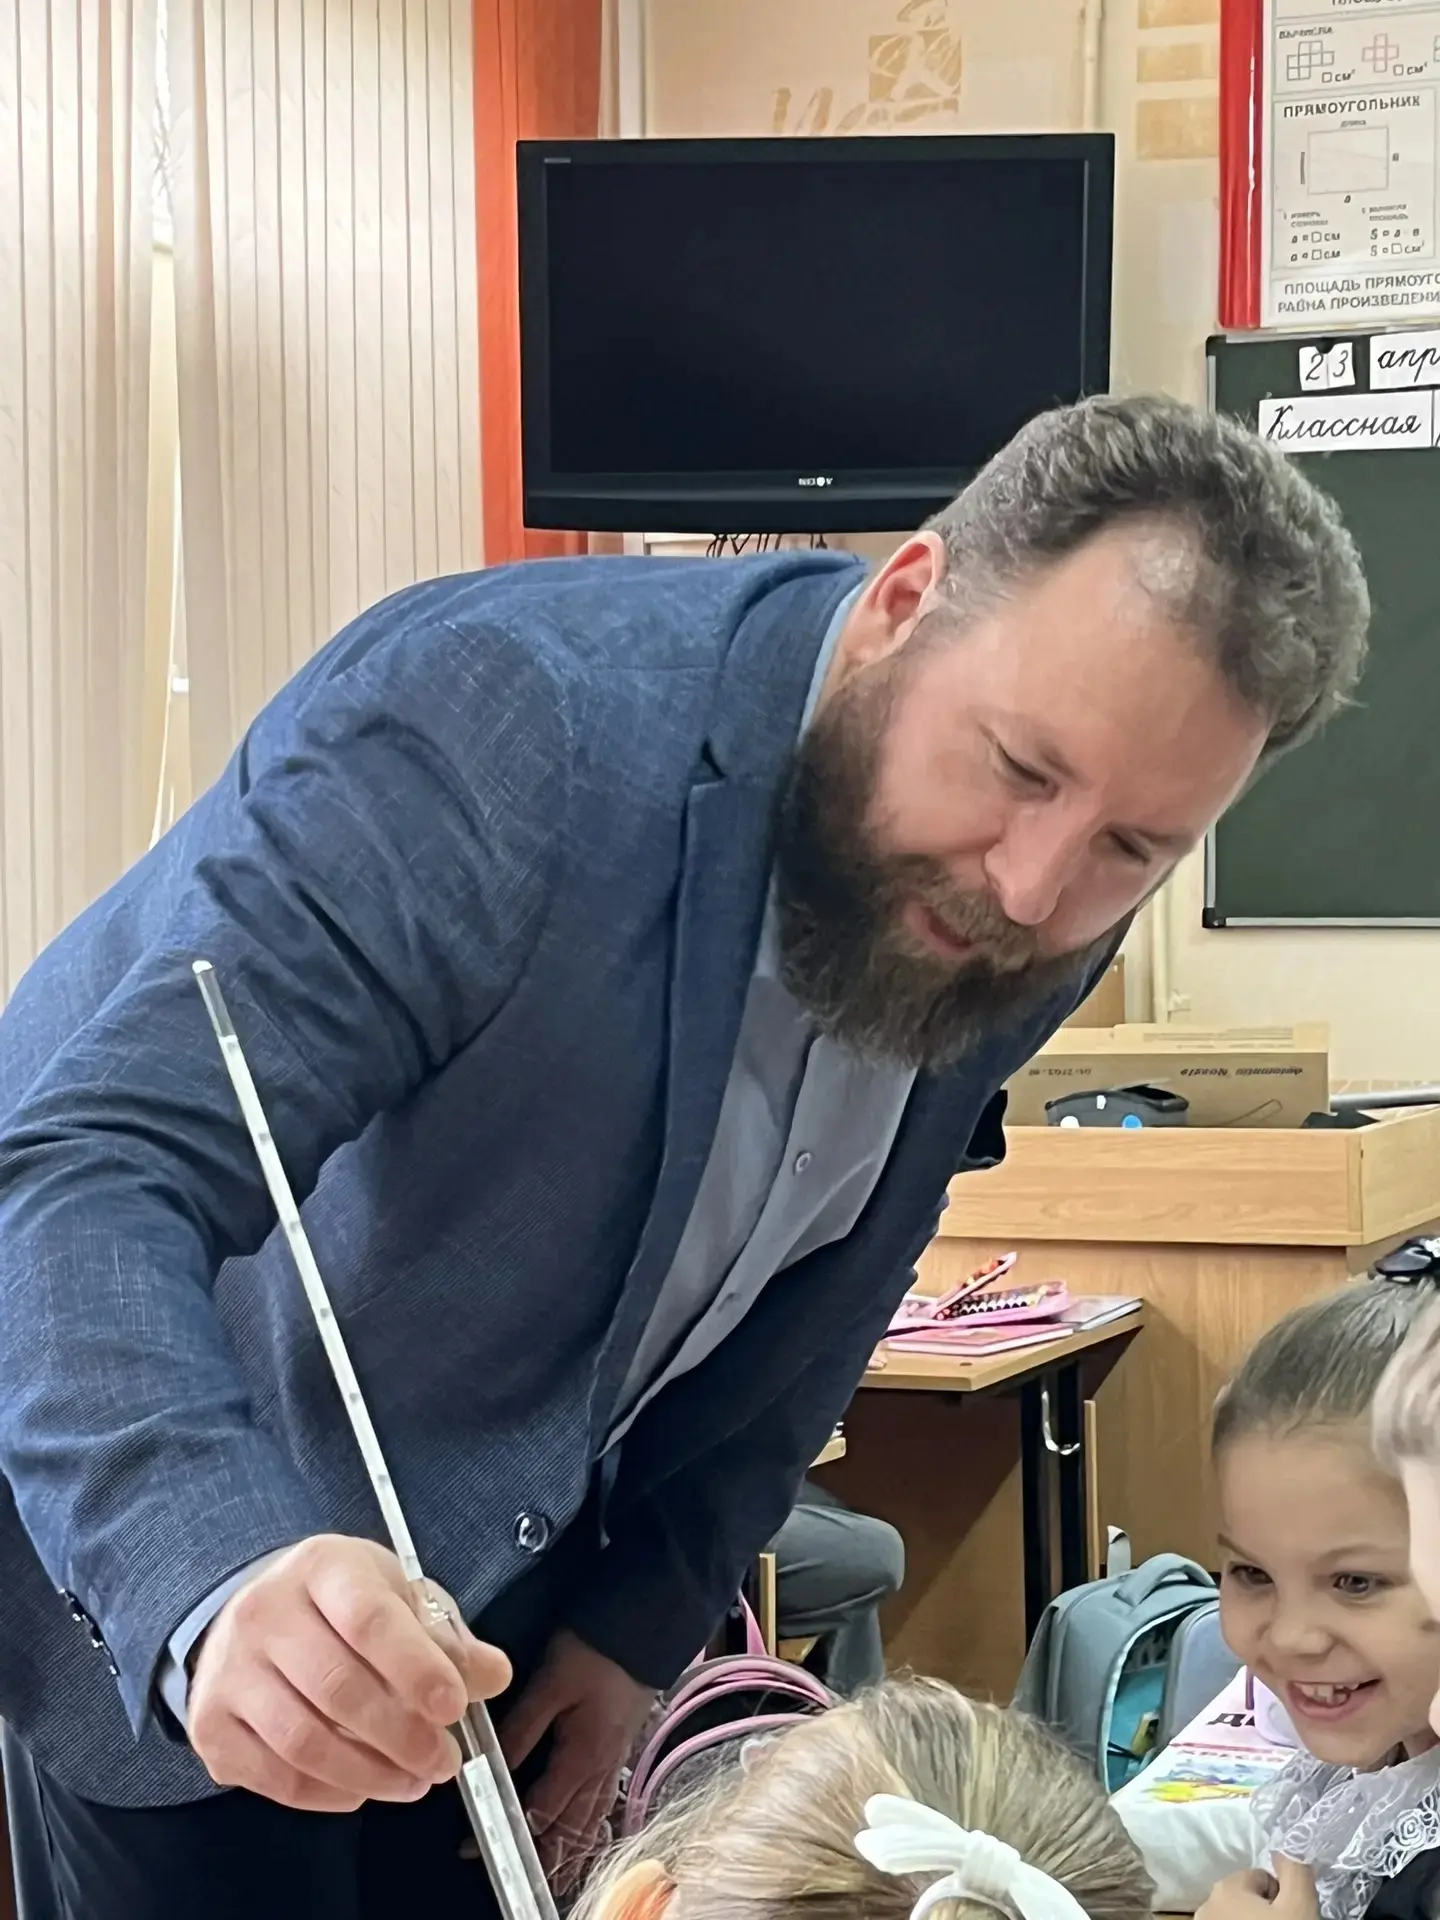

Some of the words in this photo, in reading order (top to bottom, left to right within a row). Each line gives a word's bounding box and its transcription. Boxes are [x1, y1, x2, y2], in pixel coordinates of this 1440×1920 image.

[1283, 95, 1421, 118] ПРЯМОУГОЛЬНИК
[1284, 279, 1361, 295] ПЛОЩАДЬ
[1278, 298, 1326, 313] РАВНА
[1266, 405, 1422, 440] Классная
